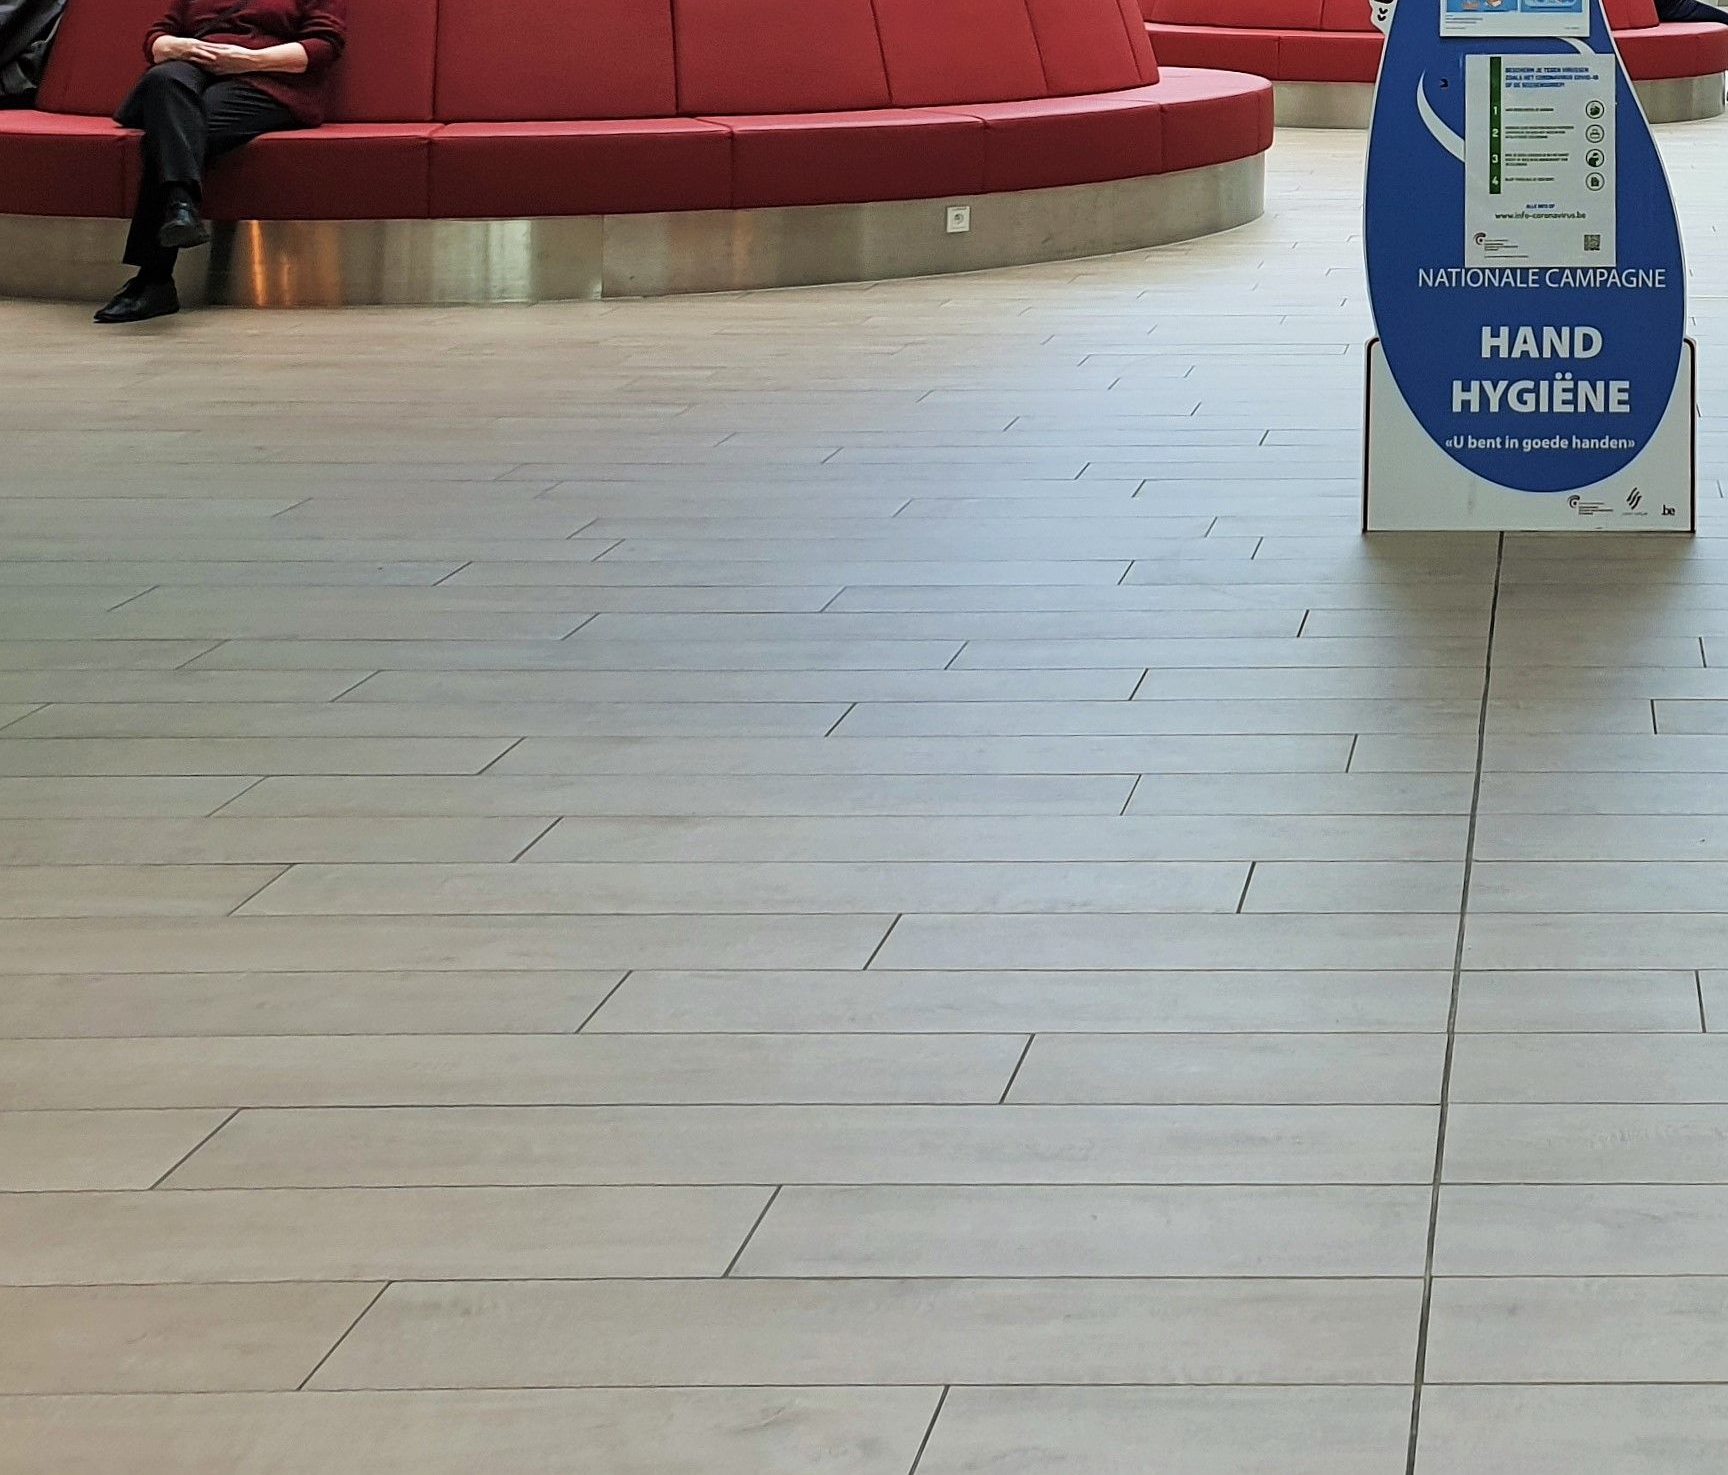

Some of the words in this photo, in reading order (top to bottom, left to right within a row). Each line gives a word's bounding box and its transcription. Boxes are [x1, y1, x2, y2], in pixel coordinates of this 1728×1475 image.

[1493, 106, 1498, 115] 1
[1492, 128, 1499, 137] 2
[1491, 154, 1499, 163] 3
[1491, 176, 1499, 185] 4
[1494, 211, 1587, 219] www.info-coronavirus.be
[1418, 268, 1540, 288] NATIONALE
[1545, 268, 1666, 288] CAMPAGNE
[1480, 325, 1603, 359] HAND
[1452, 371, 1631, 413] HYGIËNE
[1445, 435, 1464, 449] «U
[1467, 435, 1502, 449] bent
[1504, 435, 1519, 449] in
[1522, 435, 1569, 452] goede
[1572, 435, 1635, 450] handen»
